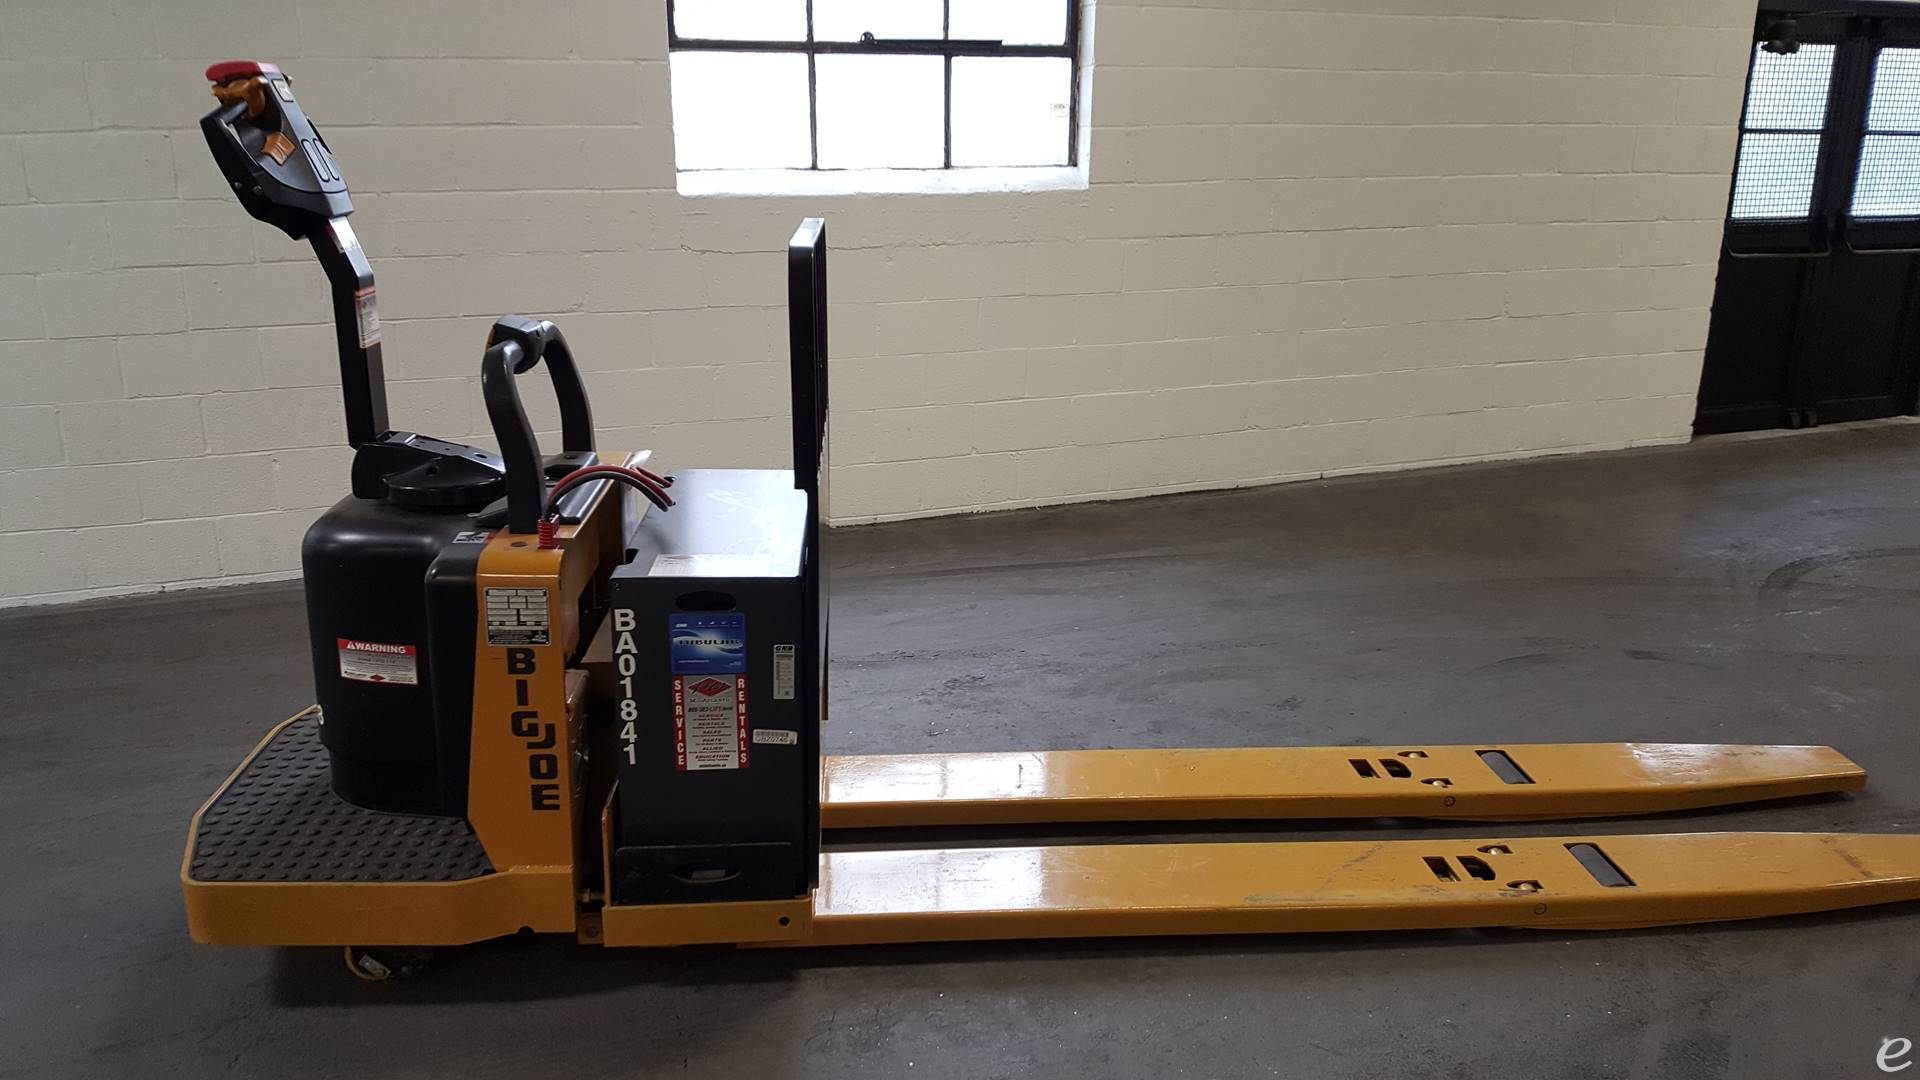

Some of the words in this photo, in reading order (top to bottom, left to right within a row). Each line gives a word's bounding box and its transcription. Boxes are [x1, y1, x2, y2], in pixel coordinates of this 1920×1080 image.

[354, 641, 407, 654] WARNING
[614, 608, 639, 765] BA01841
[674, 679, 685, 766] SERVICE
[737, 678, 748, 764] RENTALS
